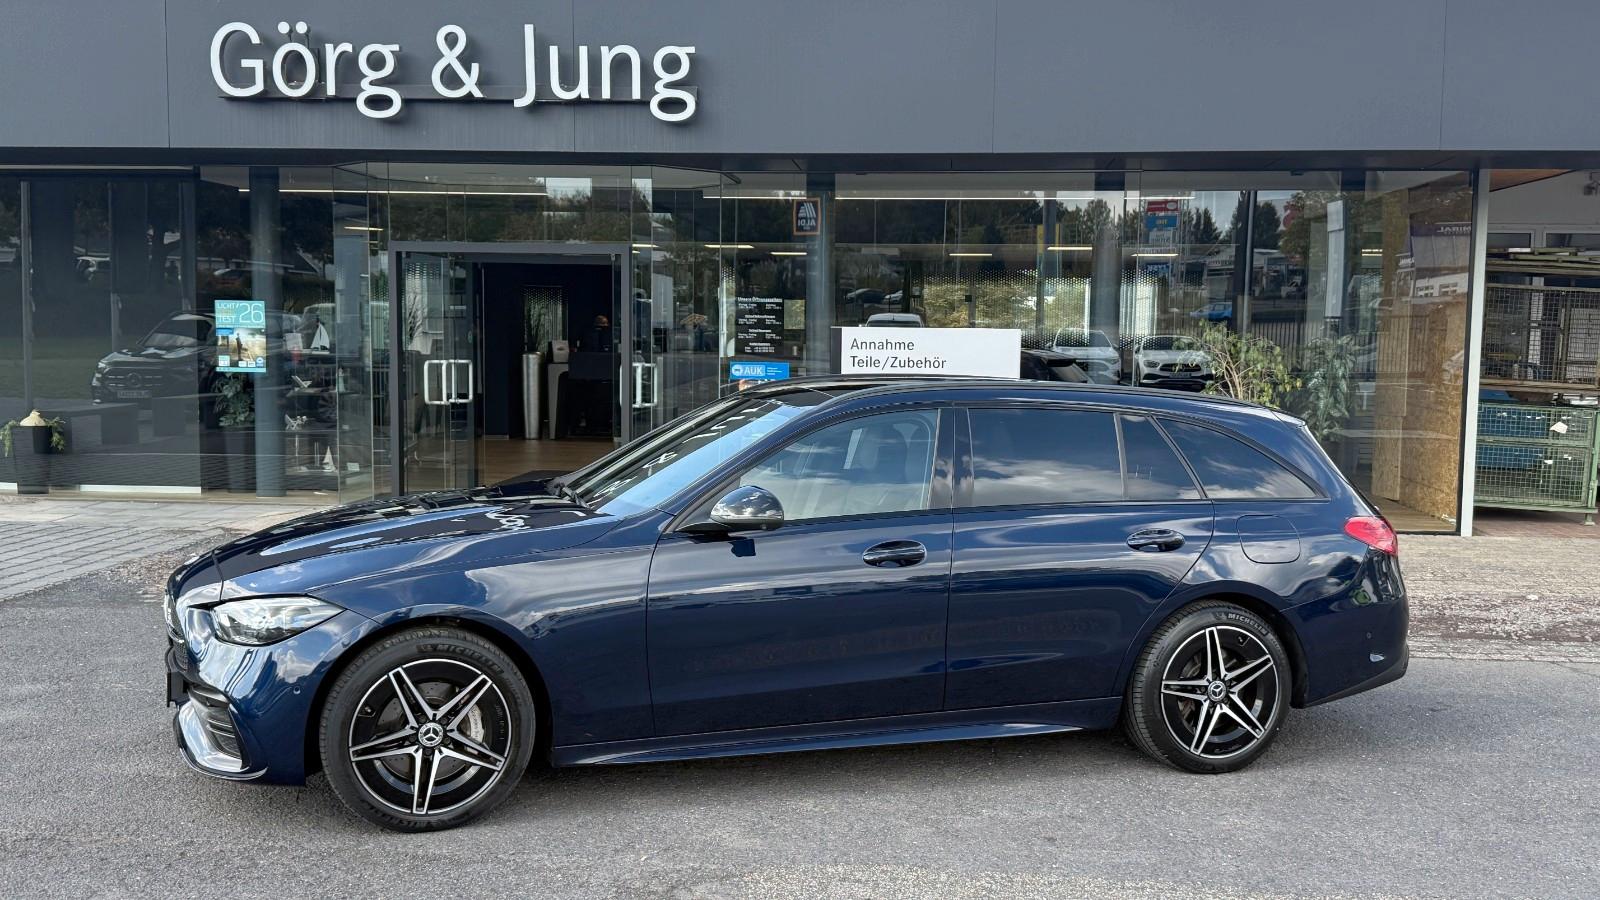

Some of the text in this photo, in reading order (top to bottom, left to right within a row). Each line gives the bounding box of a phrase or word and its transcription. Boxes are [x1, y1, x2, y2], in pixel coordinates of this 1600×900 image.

[210, 21, 697, 122] Görg & Jung
[217, 315, 236, 323] TEST
[850, 338, 915, 351] Annahme
[850, 355, 947, 371] Teile/Zubehör
[744, 366, 763, 376] AUK
[1228, 613, 1268, 636] MICHELIN
